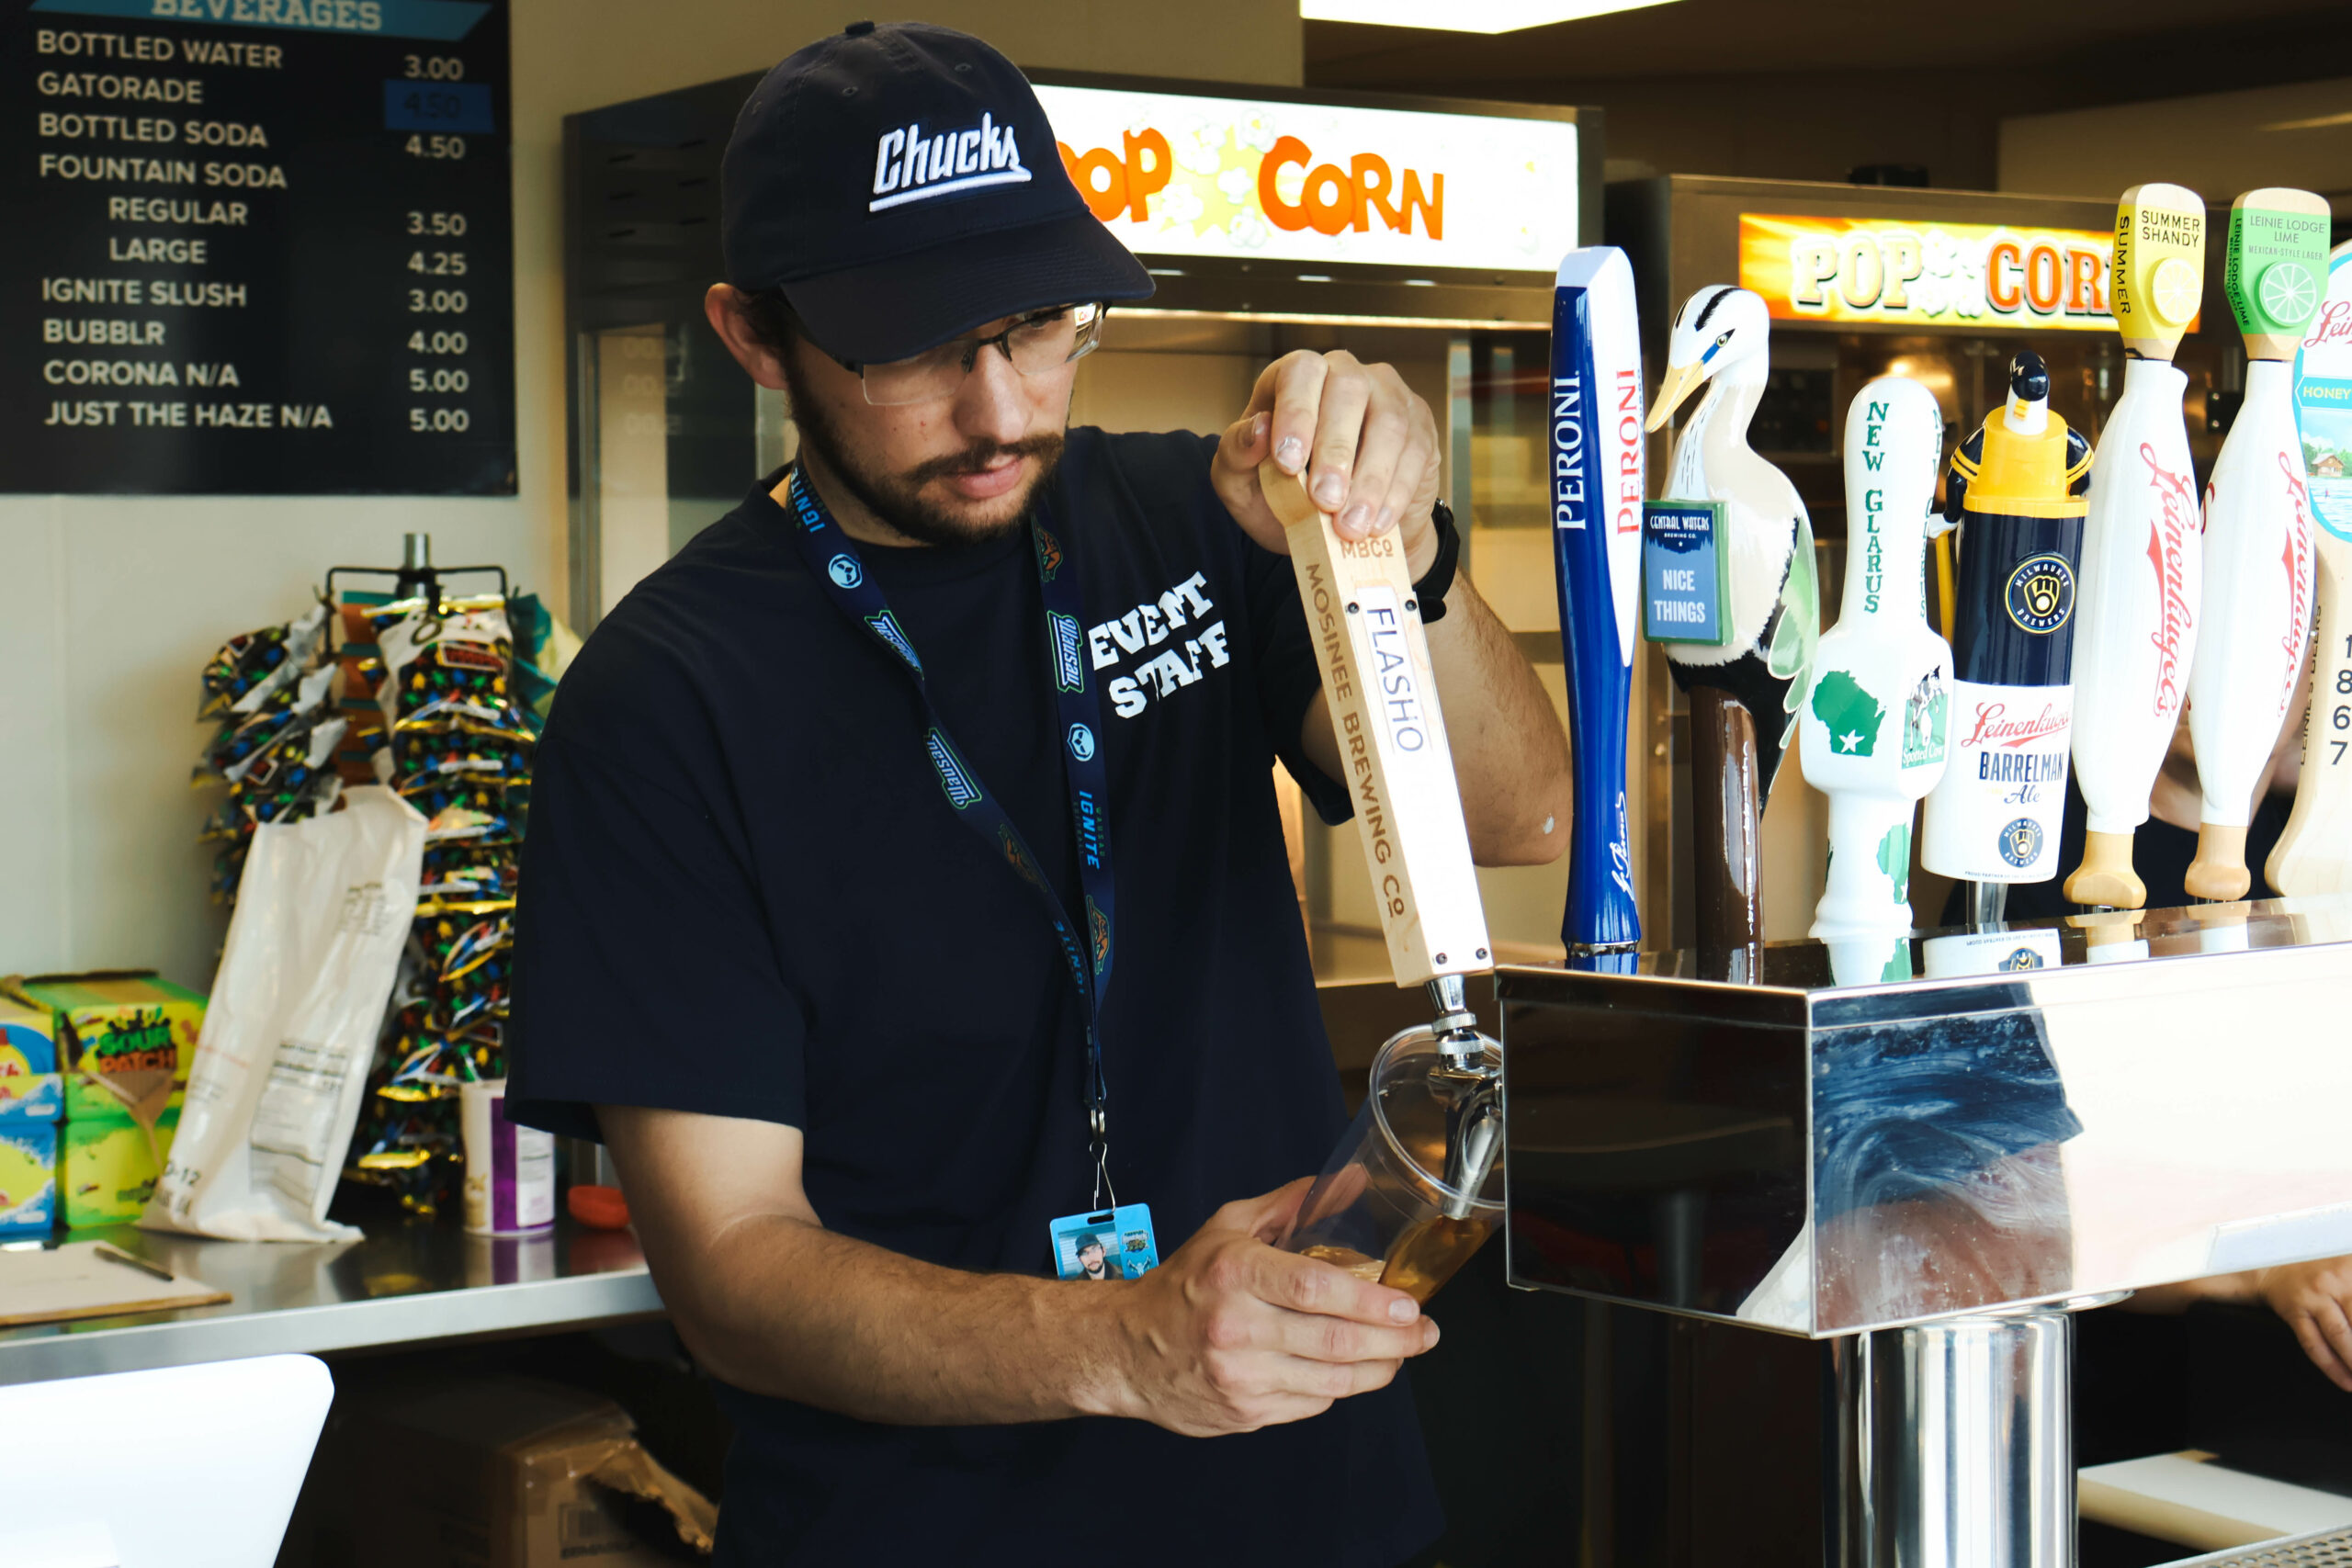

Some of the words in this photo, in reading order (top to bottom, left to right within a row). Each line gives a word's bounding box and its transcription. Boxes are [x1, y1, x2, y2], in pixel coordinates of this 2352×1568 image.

[152, 0, 382, 31] BEVERAGES
[38, 30, 175, 61] BOTTLED
[184, 40, 283, 69] WATER
[404, 55, 464, 80] 3.00
[38, 72, 203, 104] GATORADE
[39, 113, 176, 143] BOTTLED
[185, 121, 268, 148] SODA
[406, 136, 466, 159] 4.50
[40, 154, 197, 185] FOUNTAIN
[204, 163, 288, 188] SODA
[872, 112, 1026, 197] Chucks
[1056, 127, 1172, 223] OP
[1258, 135, 1444, 241] CORN
[109, 197, 248, 226] REGULAR
[407, 212, 467, 235] 3.50
[2141, 209, 2200, 232] SUMMER
[2250, 215, 2283, 229] LEINIE
[2286, 220, 2325, 233] LODGE
[2142, 226, 2199, 248] SHANDY
[2233, 218, 2243, 254] LEINIE
[2274, 231, 2300, 243] LIME
[110, 238, 207, 264] LARGE
[407, 253, 468, 276] 4.25
[2116, 215, 2132, 314] SUMMER
[2301, 251, 2324, 261] LAGER
[1796, 234, 1923, 310] POP
[1985, 239, 2116, 316] COR
[2231, 257, 2242, 299] LODGE
[42, 278, 142, 304] IGNITE
[150, 283, 247, 308] SLUSH
[408, 289, 468, 313] 3.00
[2236, 300, 2250, 326] LIME
[44, 320, 165, 345] BUBBLR
[408, 331, 468, 355] 4.00
[44, 360, 179, 386] CORONA
[186, 364, 240, 388] N/A
[409, 369, 469, 393] 5.00
[2302, 385, 2351, 400] HONEY
[45, 402, 120, 427] JUST
[129, 403, 187, 427] THE
[195, 404, 273, 428] HAZE
[280, 405, 333, 429] N/A
[409, 409, 469, 432] 5.00
[1616, 369, 1640, 536] PERONI
[1861, 400, 1890, 472] NEW
[790, 467, 826, 534] IGNITE
[1649, 515, 1680, 530] CENTRAL
[1681, 515, 1710, 531] WATERS
[1863, 489, 1883, 615] GLARUS
[1662, 569, 1696, 592] NICE
[2014, 563, 2070, 588] MILWAUKEE
[1087, 570, 1214, 671] EVENT
[1654, 600, 1706, 625] THINGS
[2017, 607, 2065, 627] BREWERS
[1057, 616, 1080, 687] Wausau
[1108, 619, 1230, 719] STAFF
[1366, 607, 1424, 753] FLASHO
[2335, 669, 2352, 695] 8
[1306, 563, 1352, 703] MOSINEE
[1341, 711, 1392, 865] BREWING
[2333, 705, 2351, 731] 6
[1903, 745, 1928, 767] Spotted
[1928, 742, 1944, 759] Cow
[1979, 751, 2064, 783] BARRELMAN
[2330, 740, 2348, 766] 7
[926, 739, 970, 806] Wausau
[2004, 784, 2041, 805] Ale
[1079, 789, 1100, 870] IGNITE
[98, 1024, 172, 1055] SOUR
